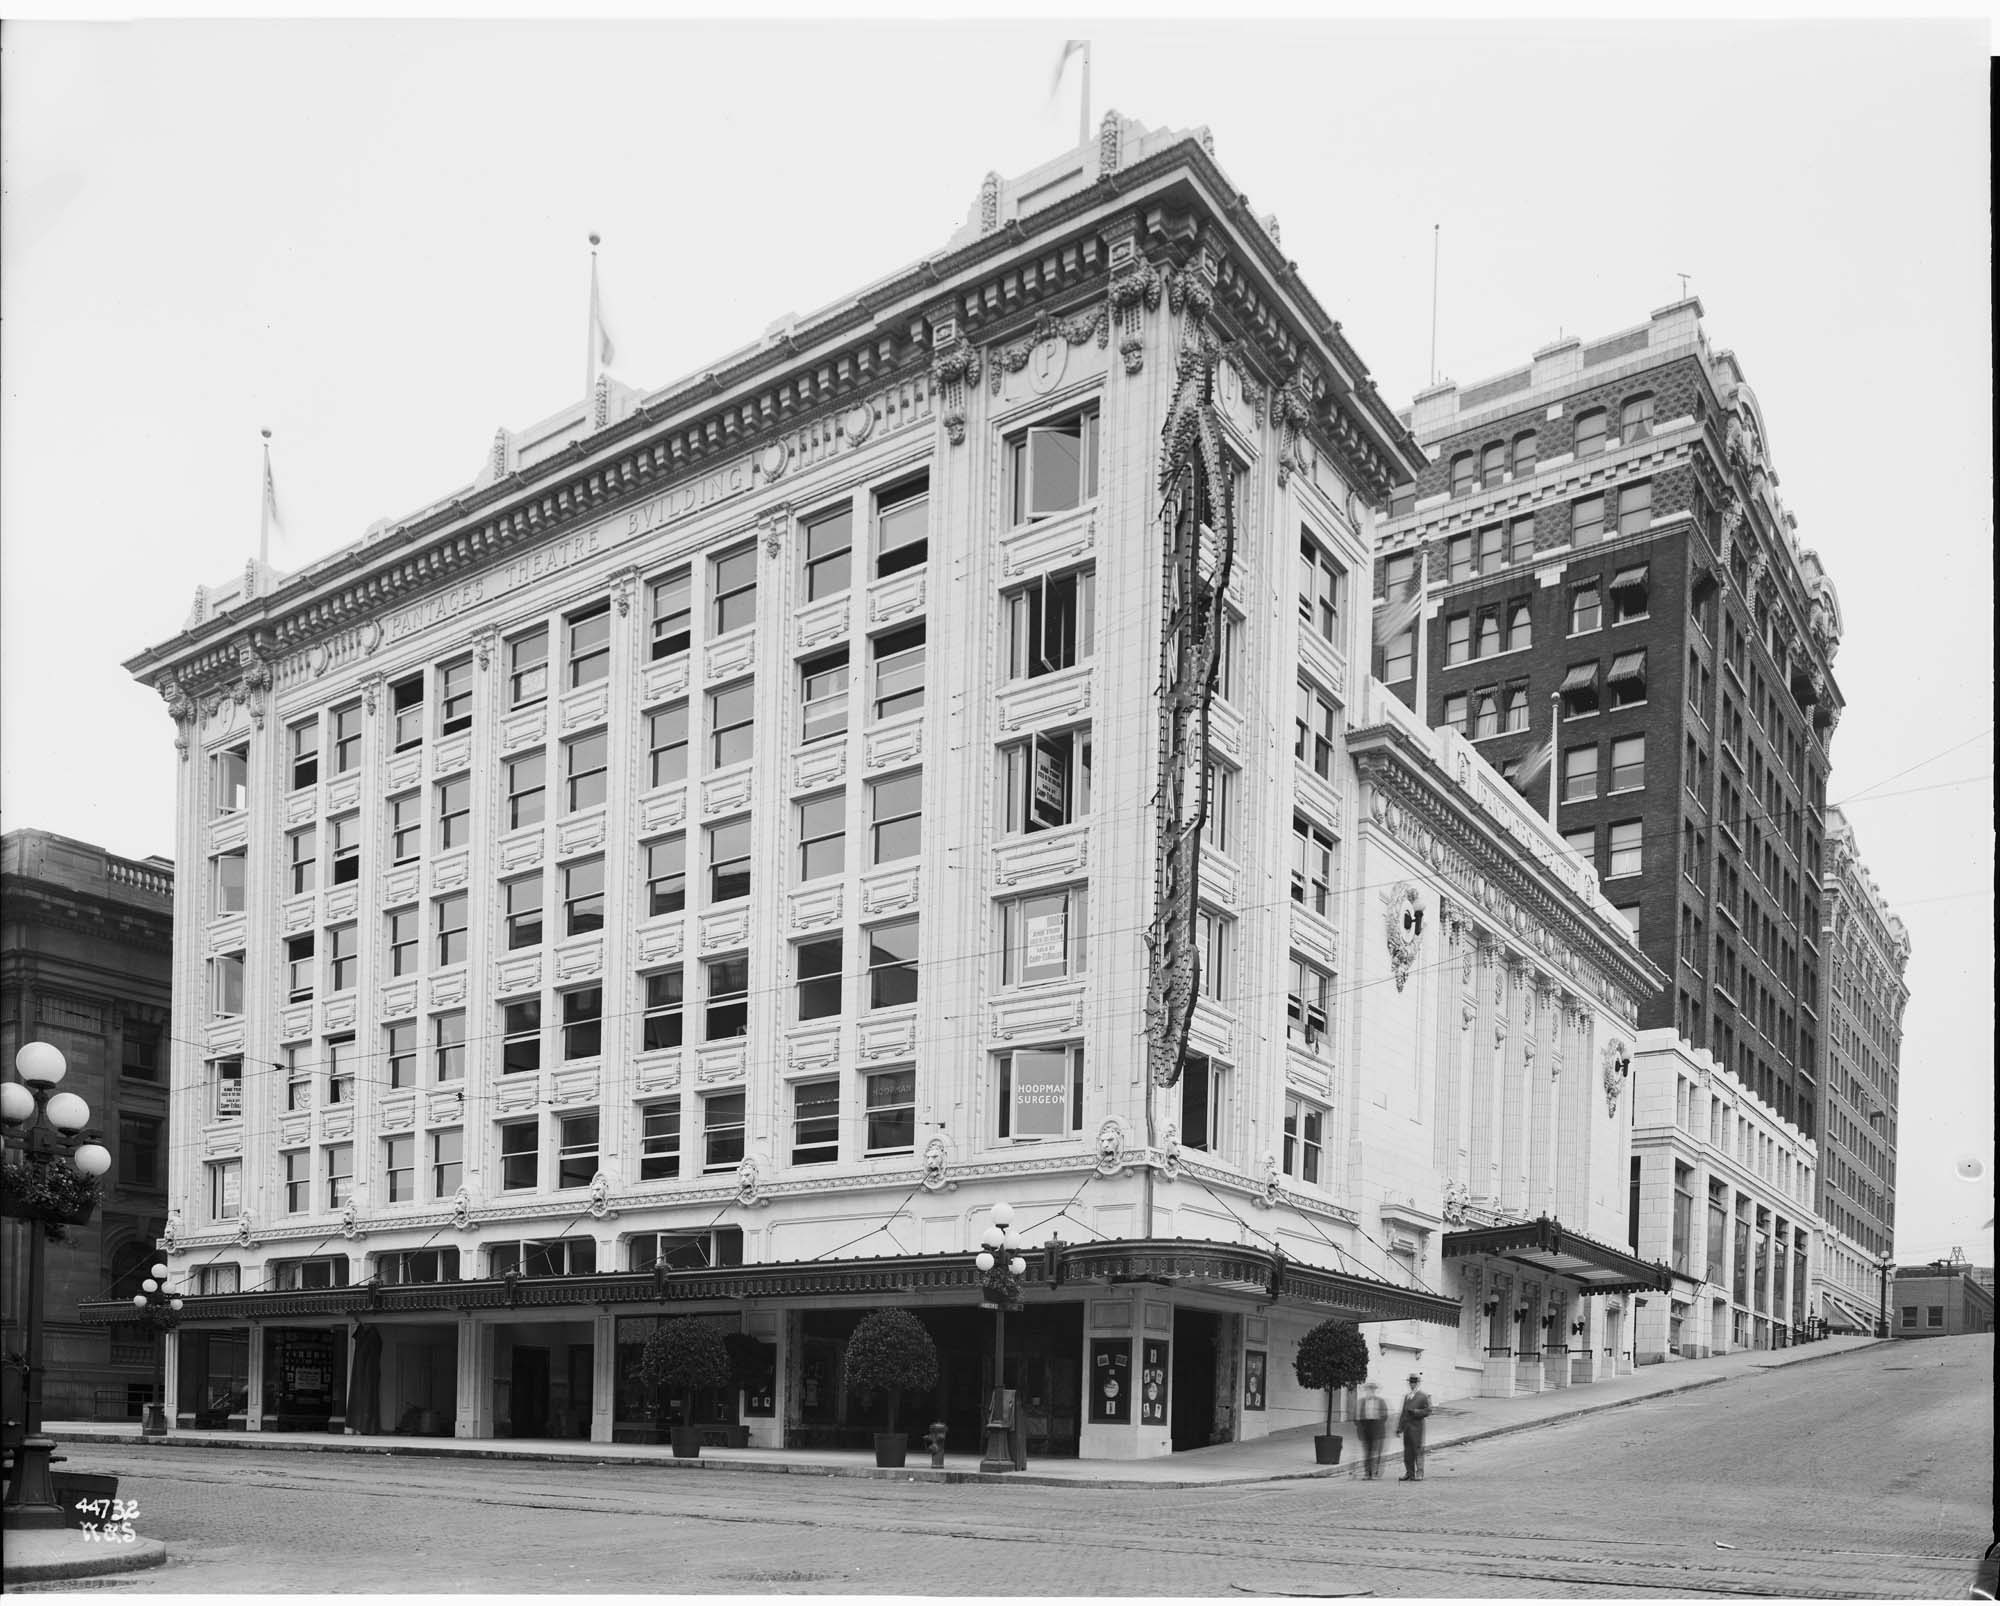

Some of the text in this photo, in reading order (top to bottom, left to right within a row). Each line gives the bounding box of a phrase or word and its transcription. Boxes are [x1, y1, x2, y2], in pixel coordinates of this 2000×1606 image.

[390, 467, 742, 637] PANTAGES THEATRE BVILDING
[1018, 1084, 1065, 1093] HOOPMAN
[1017, 1095, 1065, 1104] SURGEON
